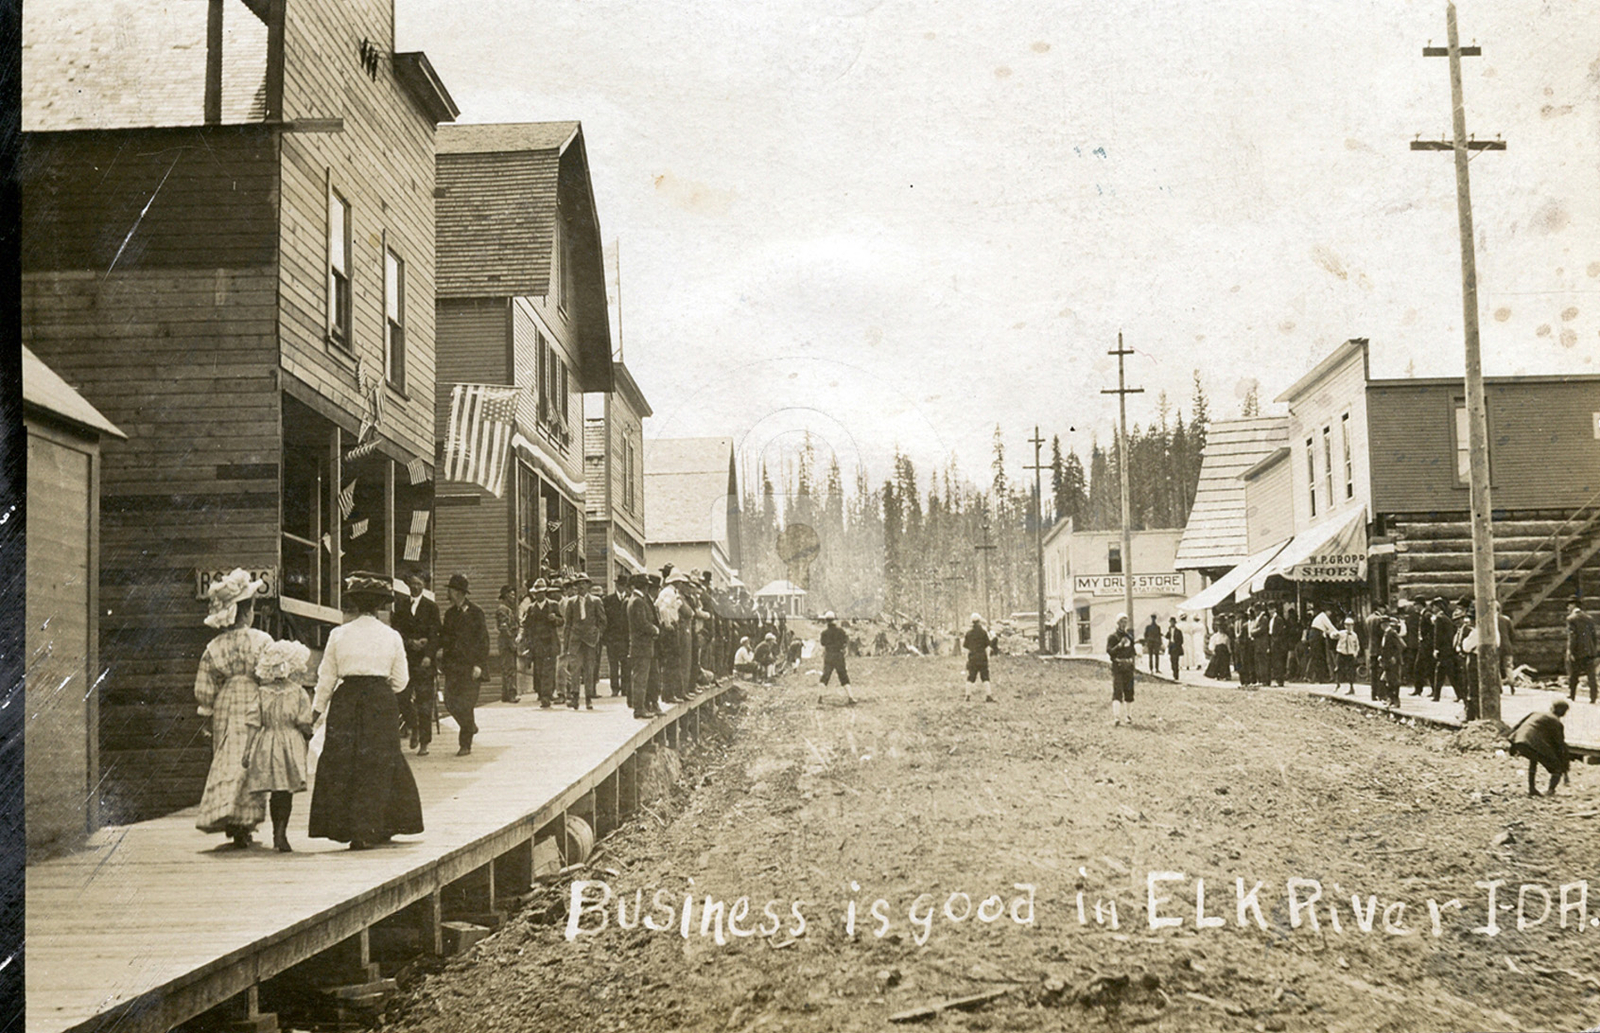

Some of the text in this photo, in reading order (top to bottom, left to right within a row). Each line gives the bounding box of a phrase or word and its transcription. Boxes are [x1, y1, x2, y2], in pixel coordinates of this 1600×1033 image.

[1301, 567, 1359, 577] SHOES
[1078, 578, 1100, 588] MY
[1139, 576, 1180, 587] STORE
